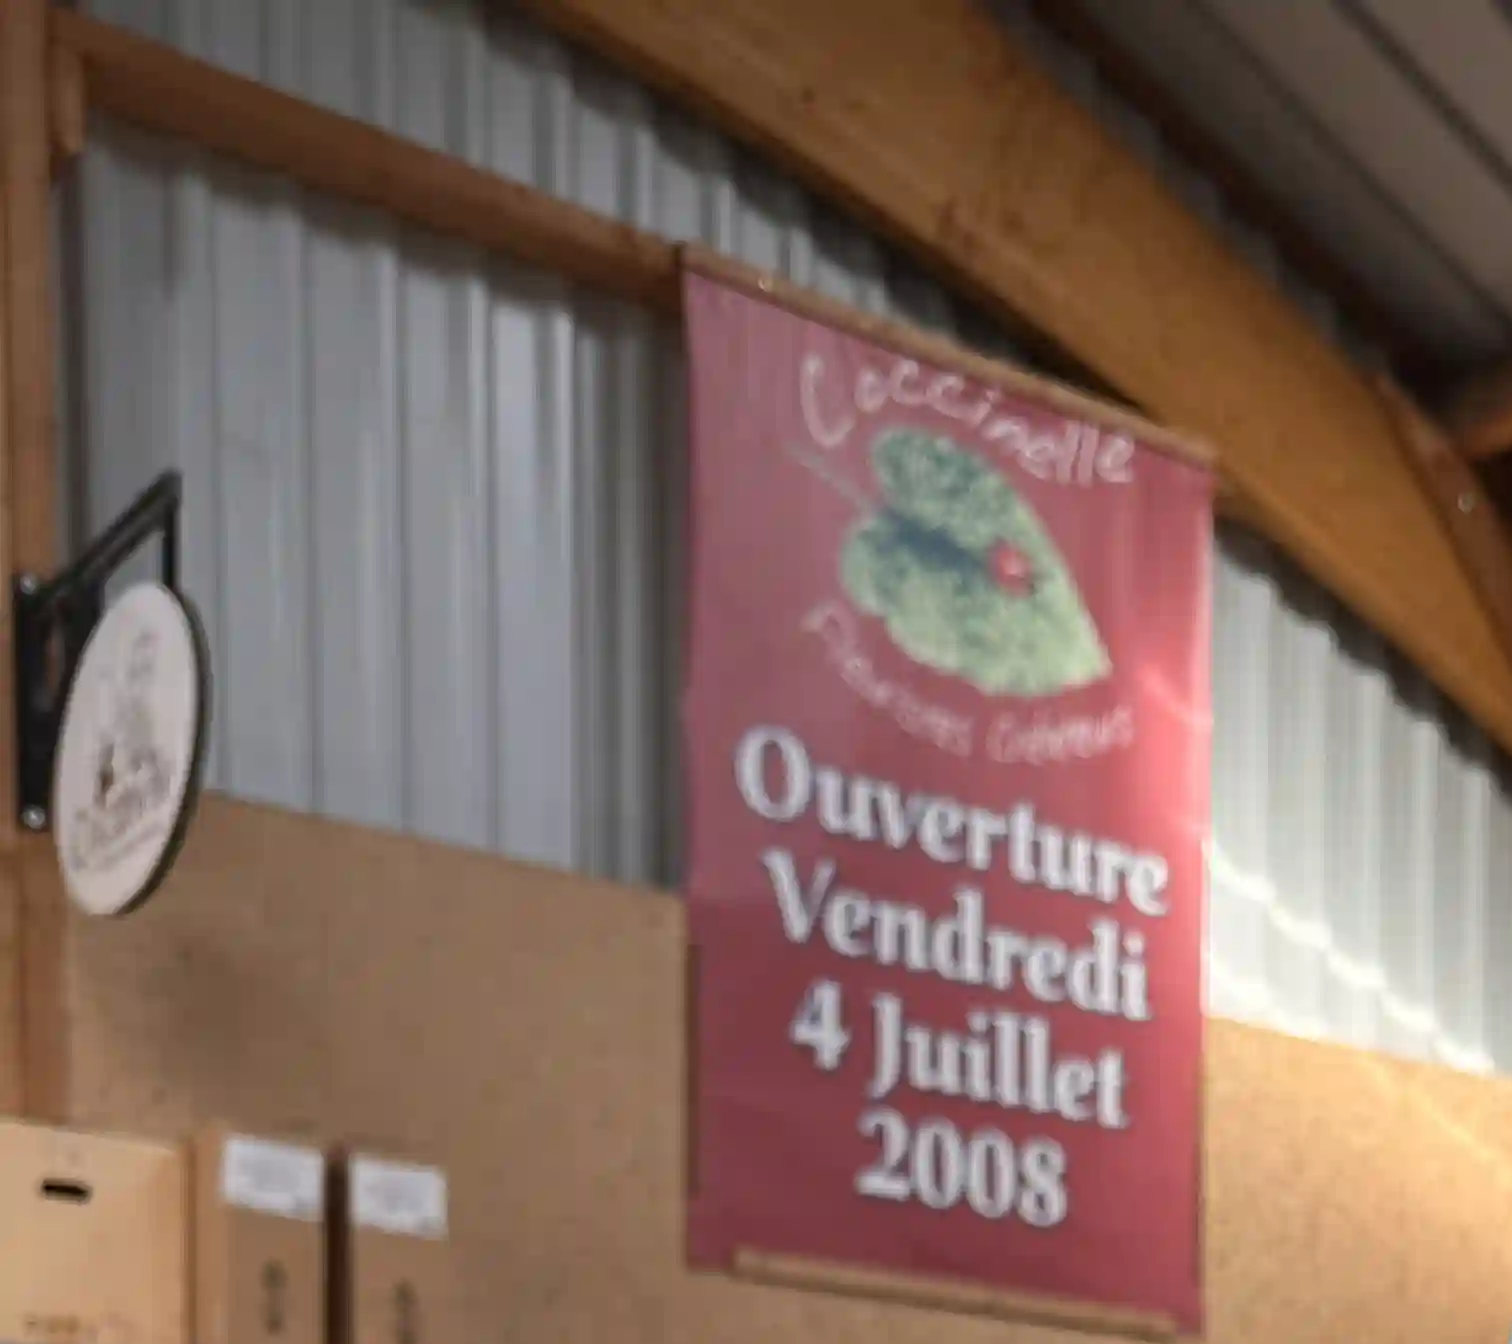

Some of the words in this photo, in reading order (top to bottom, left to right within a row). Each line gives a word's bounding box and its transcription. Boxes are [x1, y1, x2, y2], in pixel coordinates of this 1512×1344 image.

[734, 724, 1171, 916] Ouverture
[758, 846, 1153, 1023] Vendredi
[788, 976, 853, 1072] 4
[868, 991, 1133, 1131] Juillet
[855, 1107, 1071, 1228] 2008
